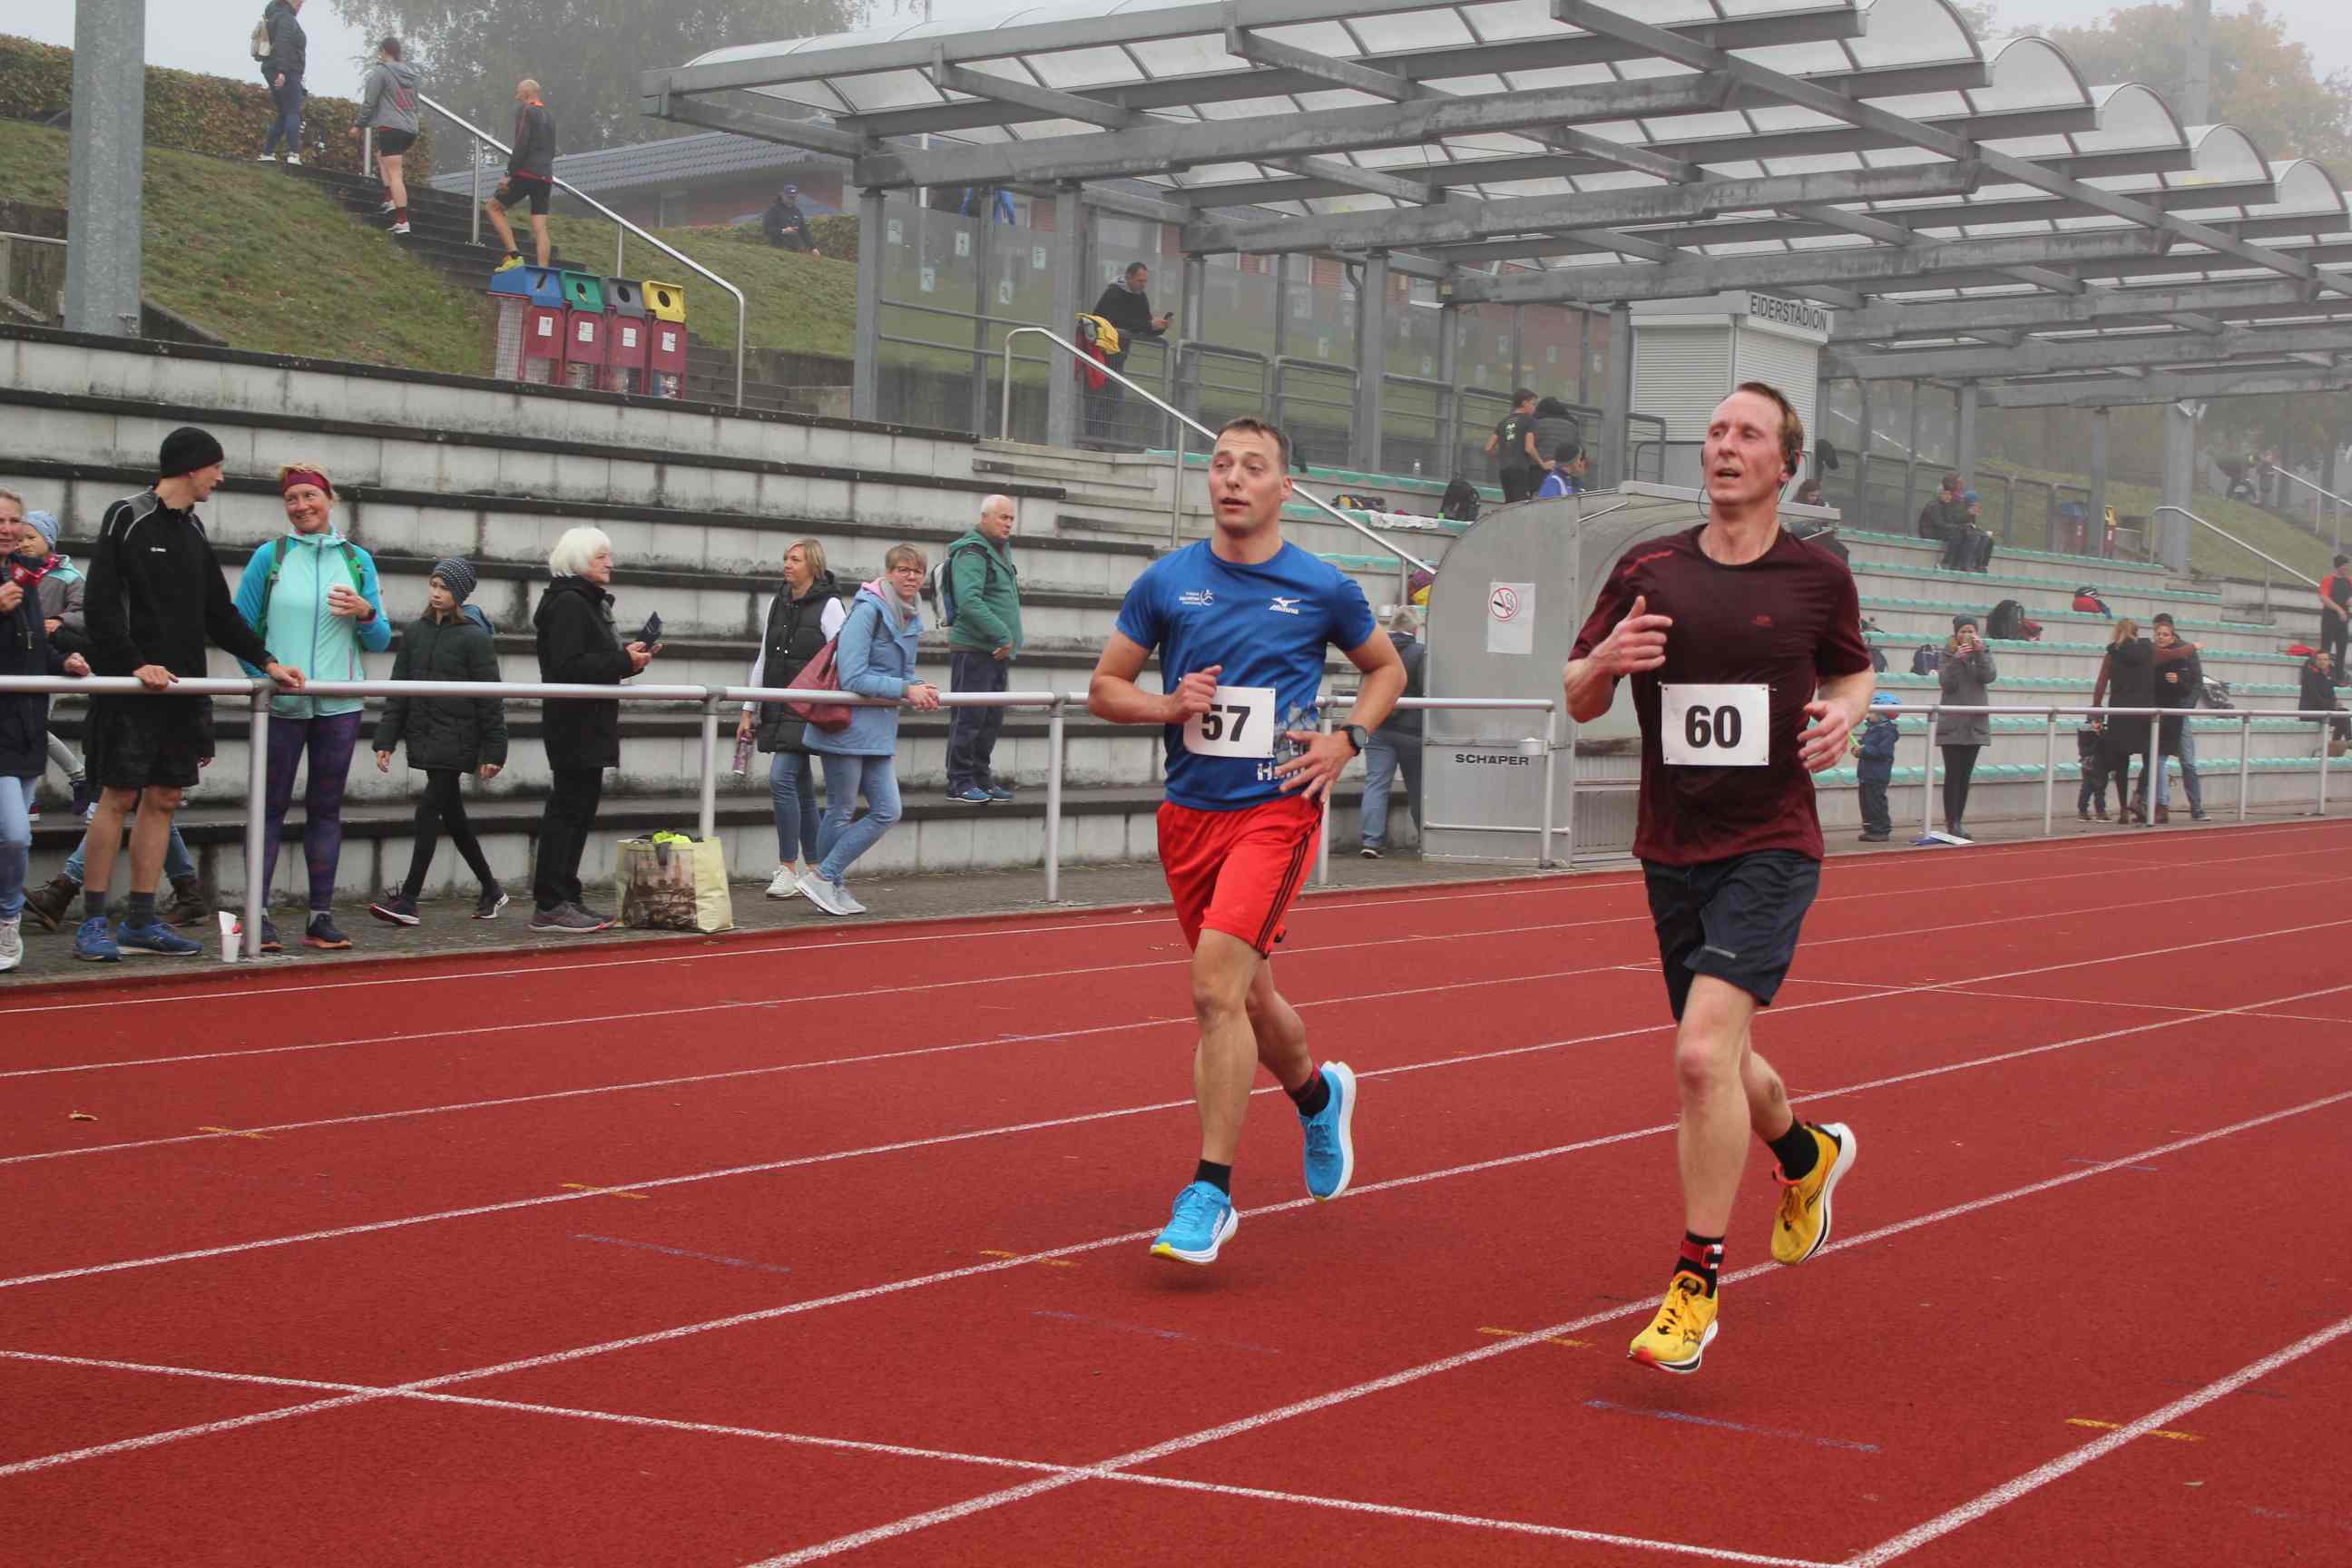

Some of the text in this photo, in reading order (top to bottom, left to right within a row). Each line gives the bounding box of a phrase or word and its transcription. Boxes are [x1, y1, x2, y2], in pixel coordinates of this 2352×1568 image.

[1749, 295, 1828, 330] EIDERSTADION
[1200, 704, 1250, 742] 57
[1685, 705, 1742, 749] 60
